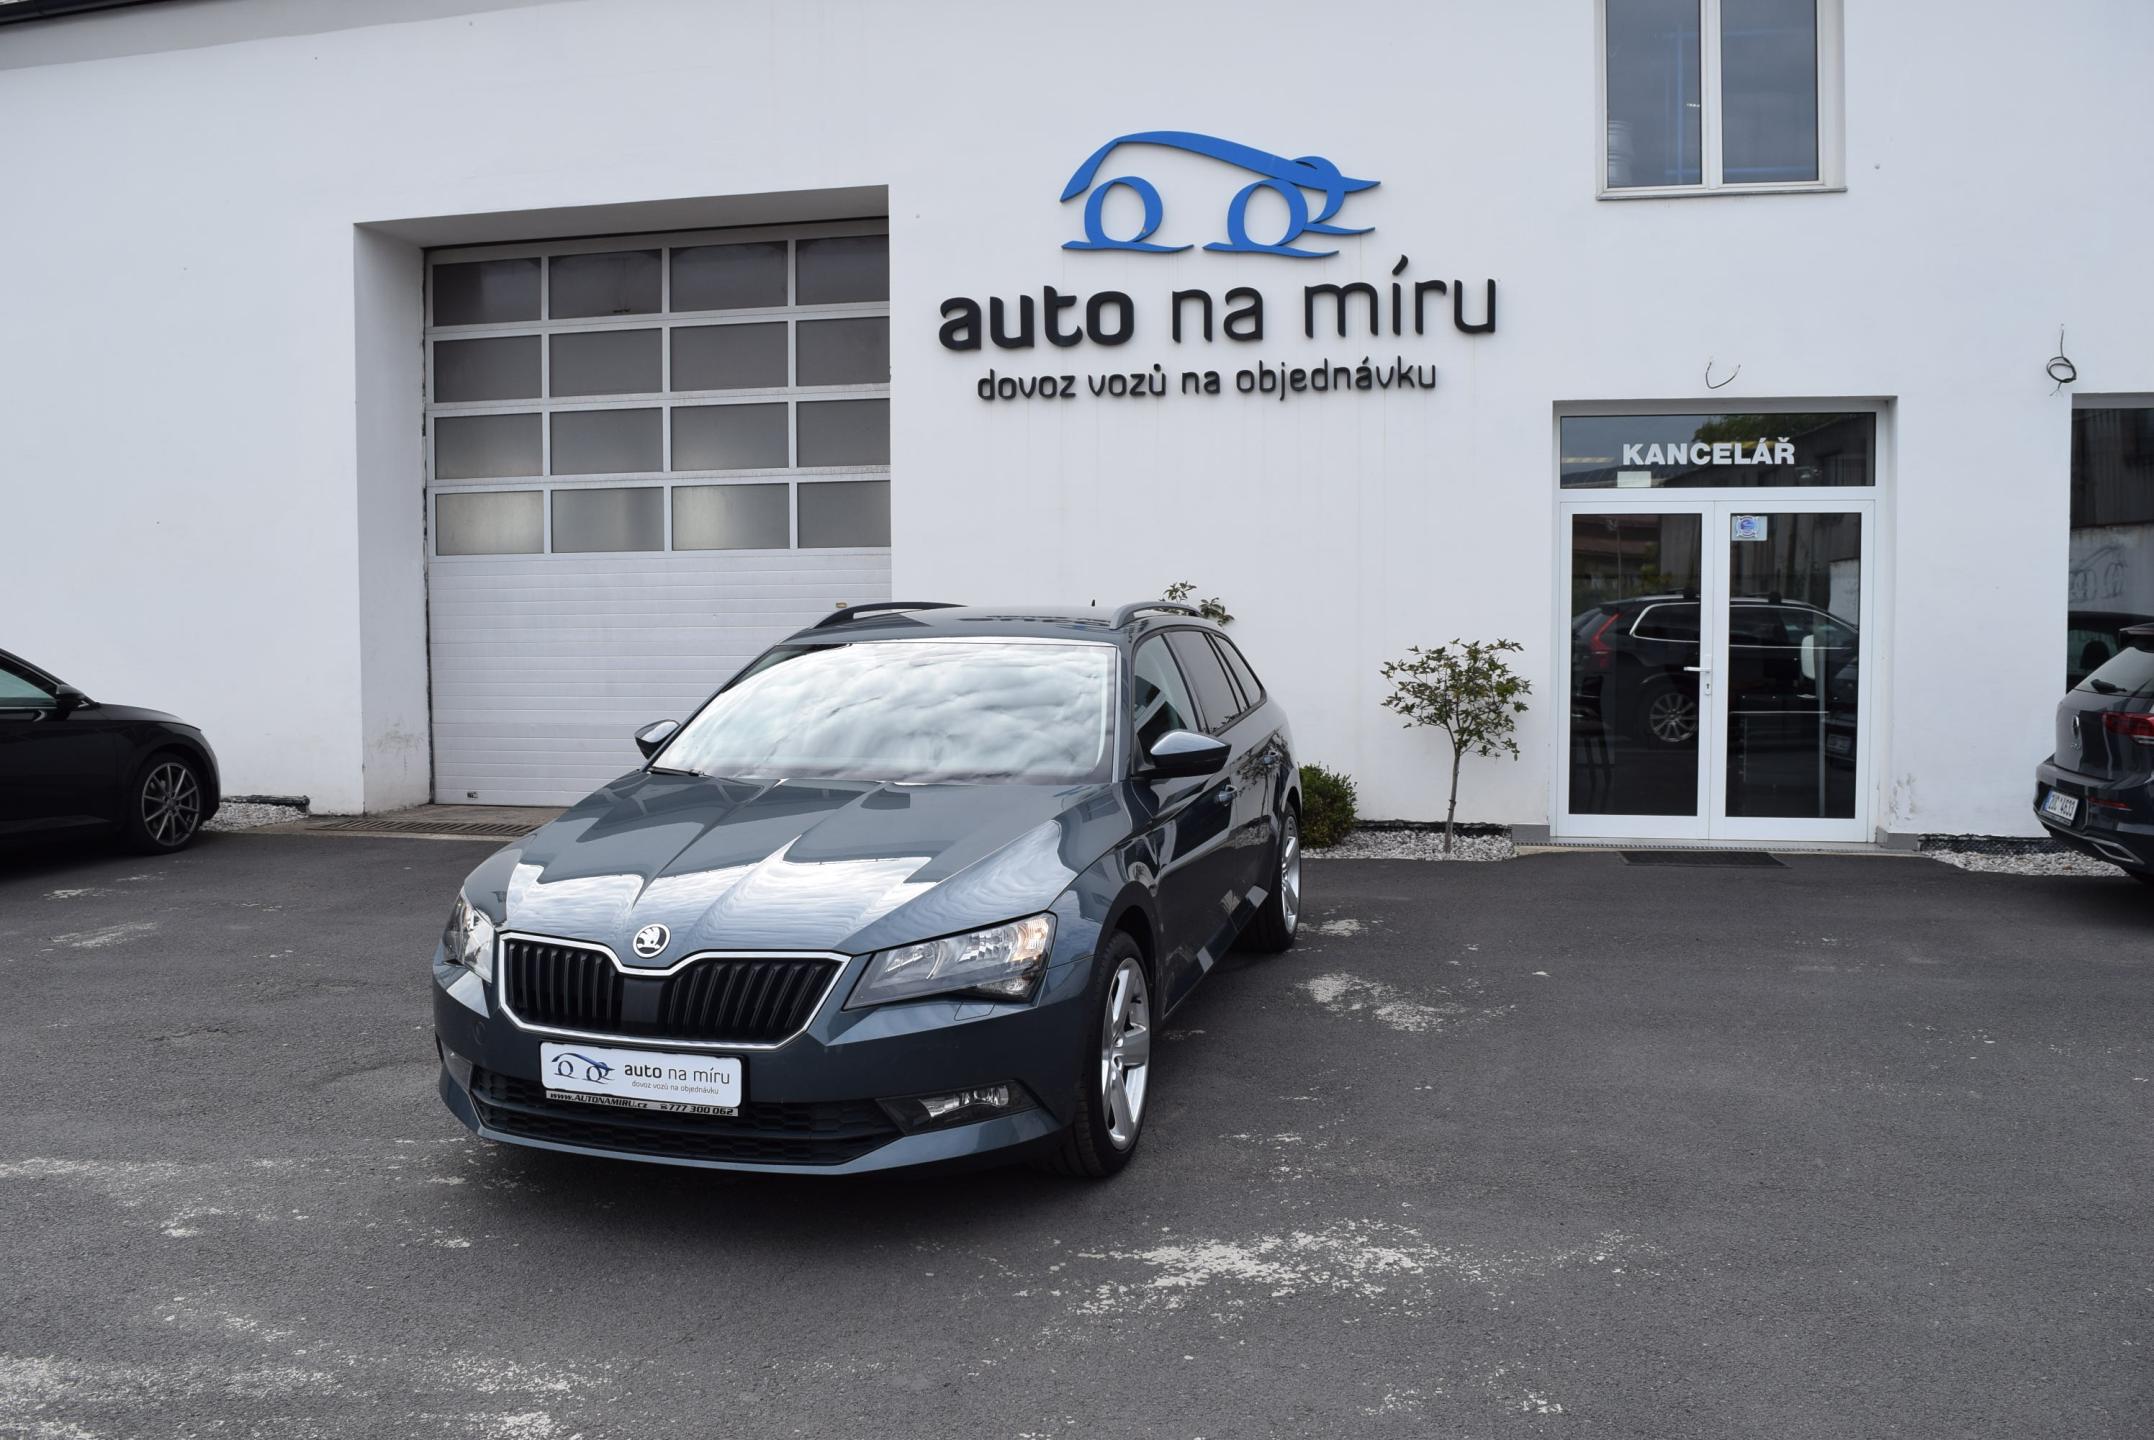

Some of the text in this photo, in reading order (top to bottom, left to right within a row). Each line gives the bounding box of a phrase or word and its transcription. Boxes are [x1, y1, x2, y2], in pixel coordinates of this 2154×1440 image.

[938, 254, 1497, 351] auto na míru
[977, 355, 1437, 402] dovoz vozů na objednávku
[1623, 437, 1795, 466] KANCELÁŘ
[624, 1064, 730, 1085] auto na míru
[631, 1081, 651, 1089] dovoz
[669, 1103, 688, 1113] 777
